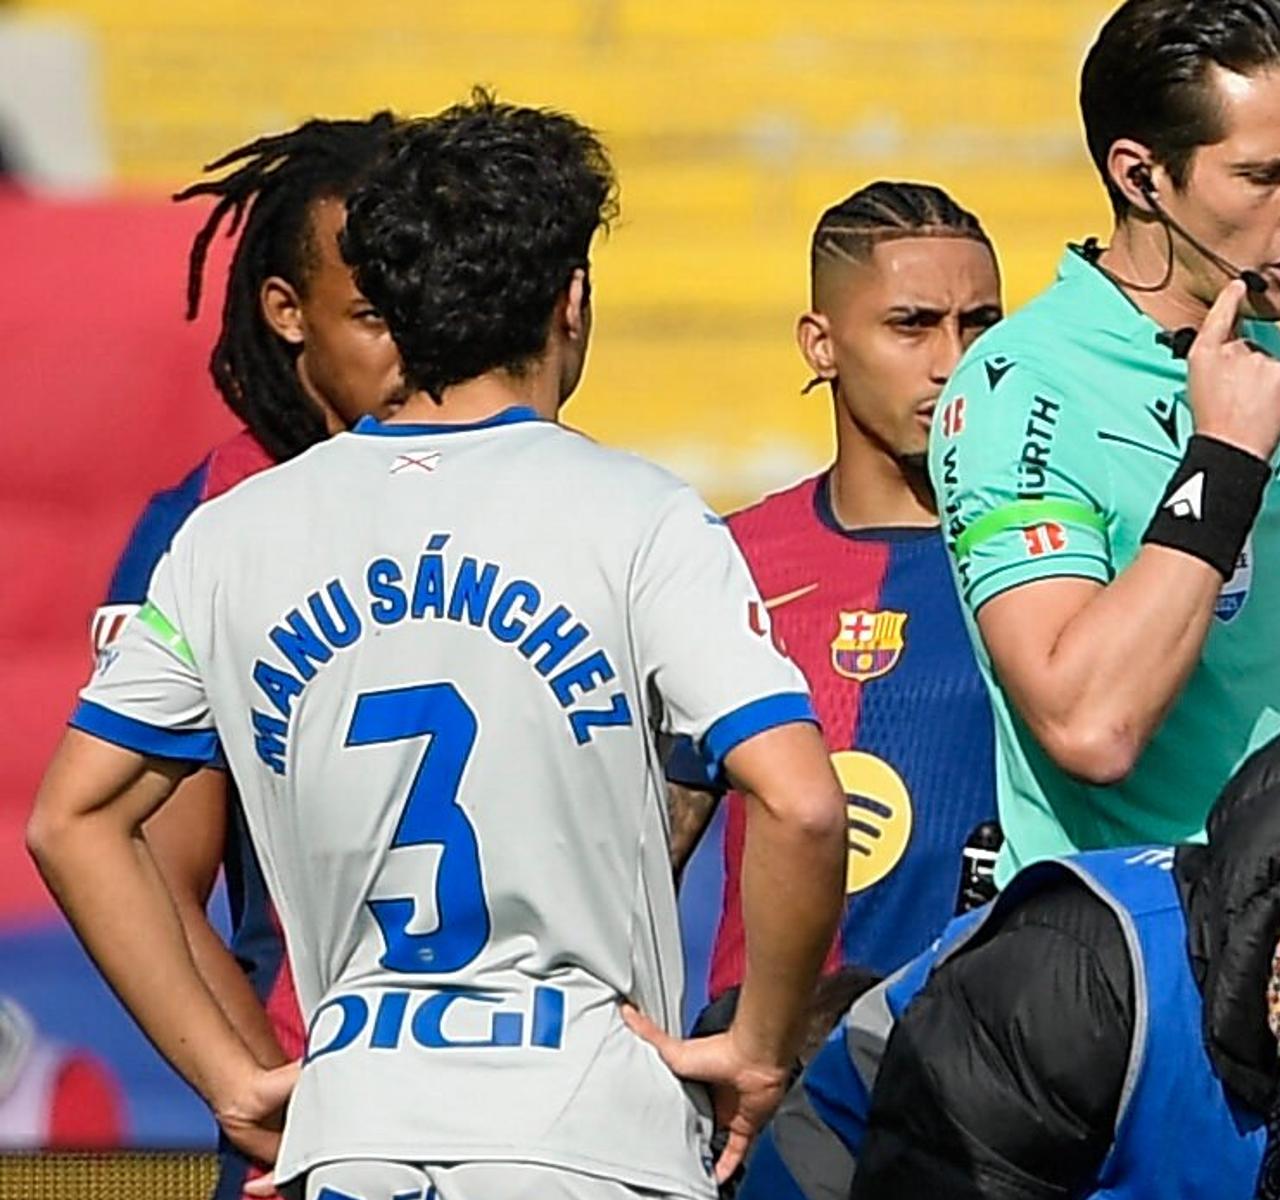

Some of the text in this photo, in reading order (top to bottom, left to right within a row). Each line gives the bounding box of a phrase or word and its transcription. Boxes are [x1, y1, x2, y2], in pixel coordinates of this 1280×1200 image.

[1017, 395, 1060, 501] ÜRTH
[250, 533, 634, 775] MANU SÁNCHEZ
[345, 681, 491, 974] 3
